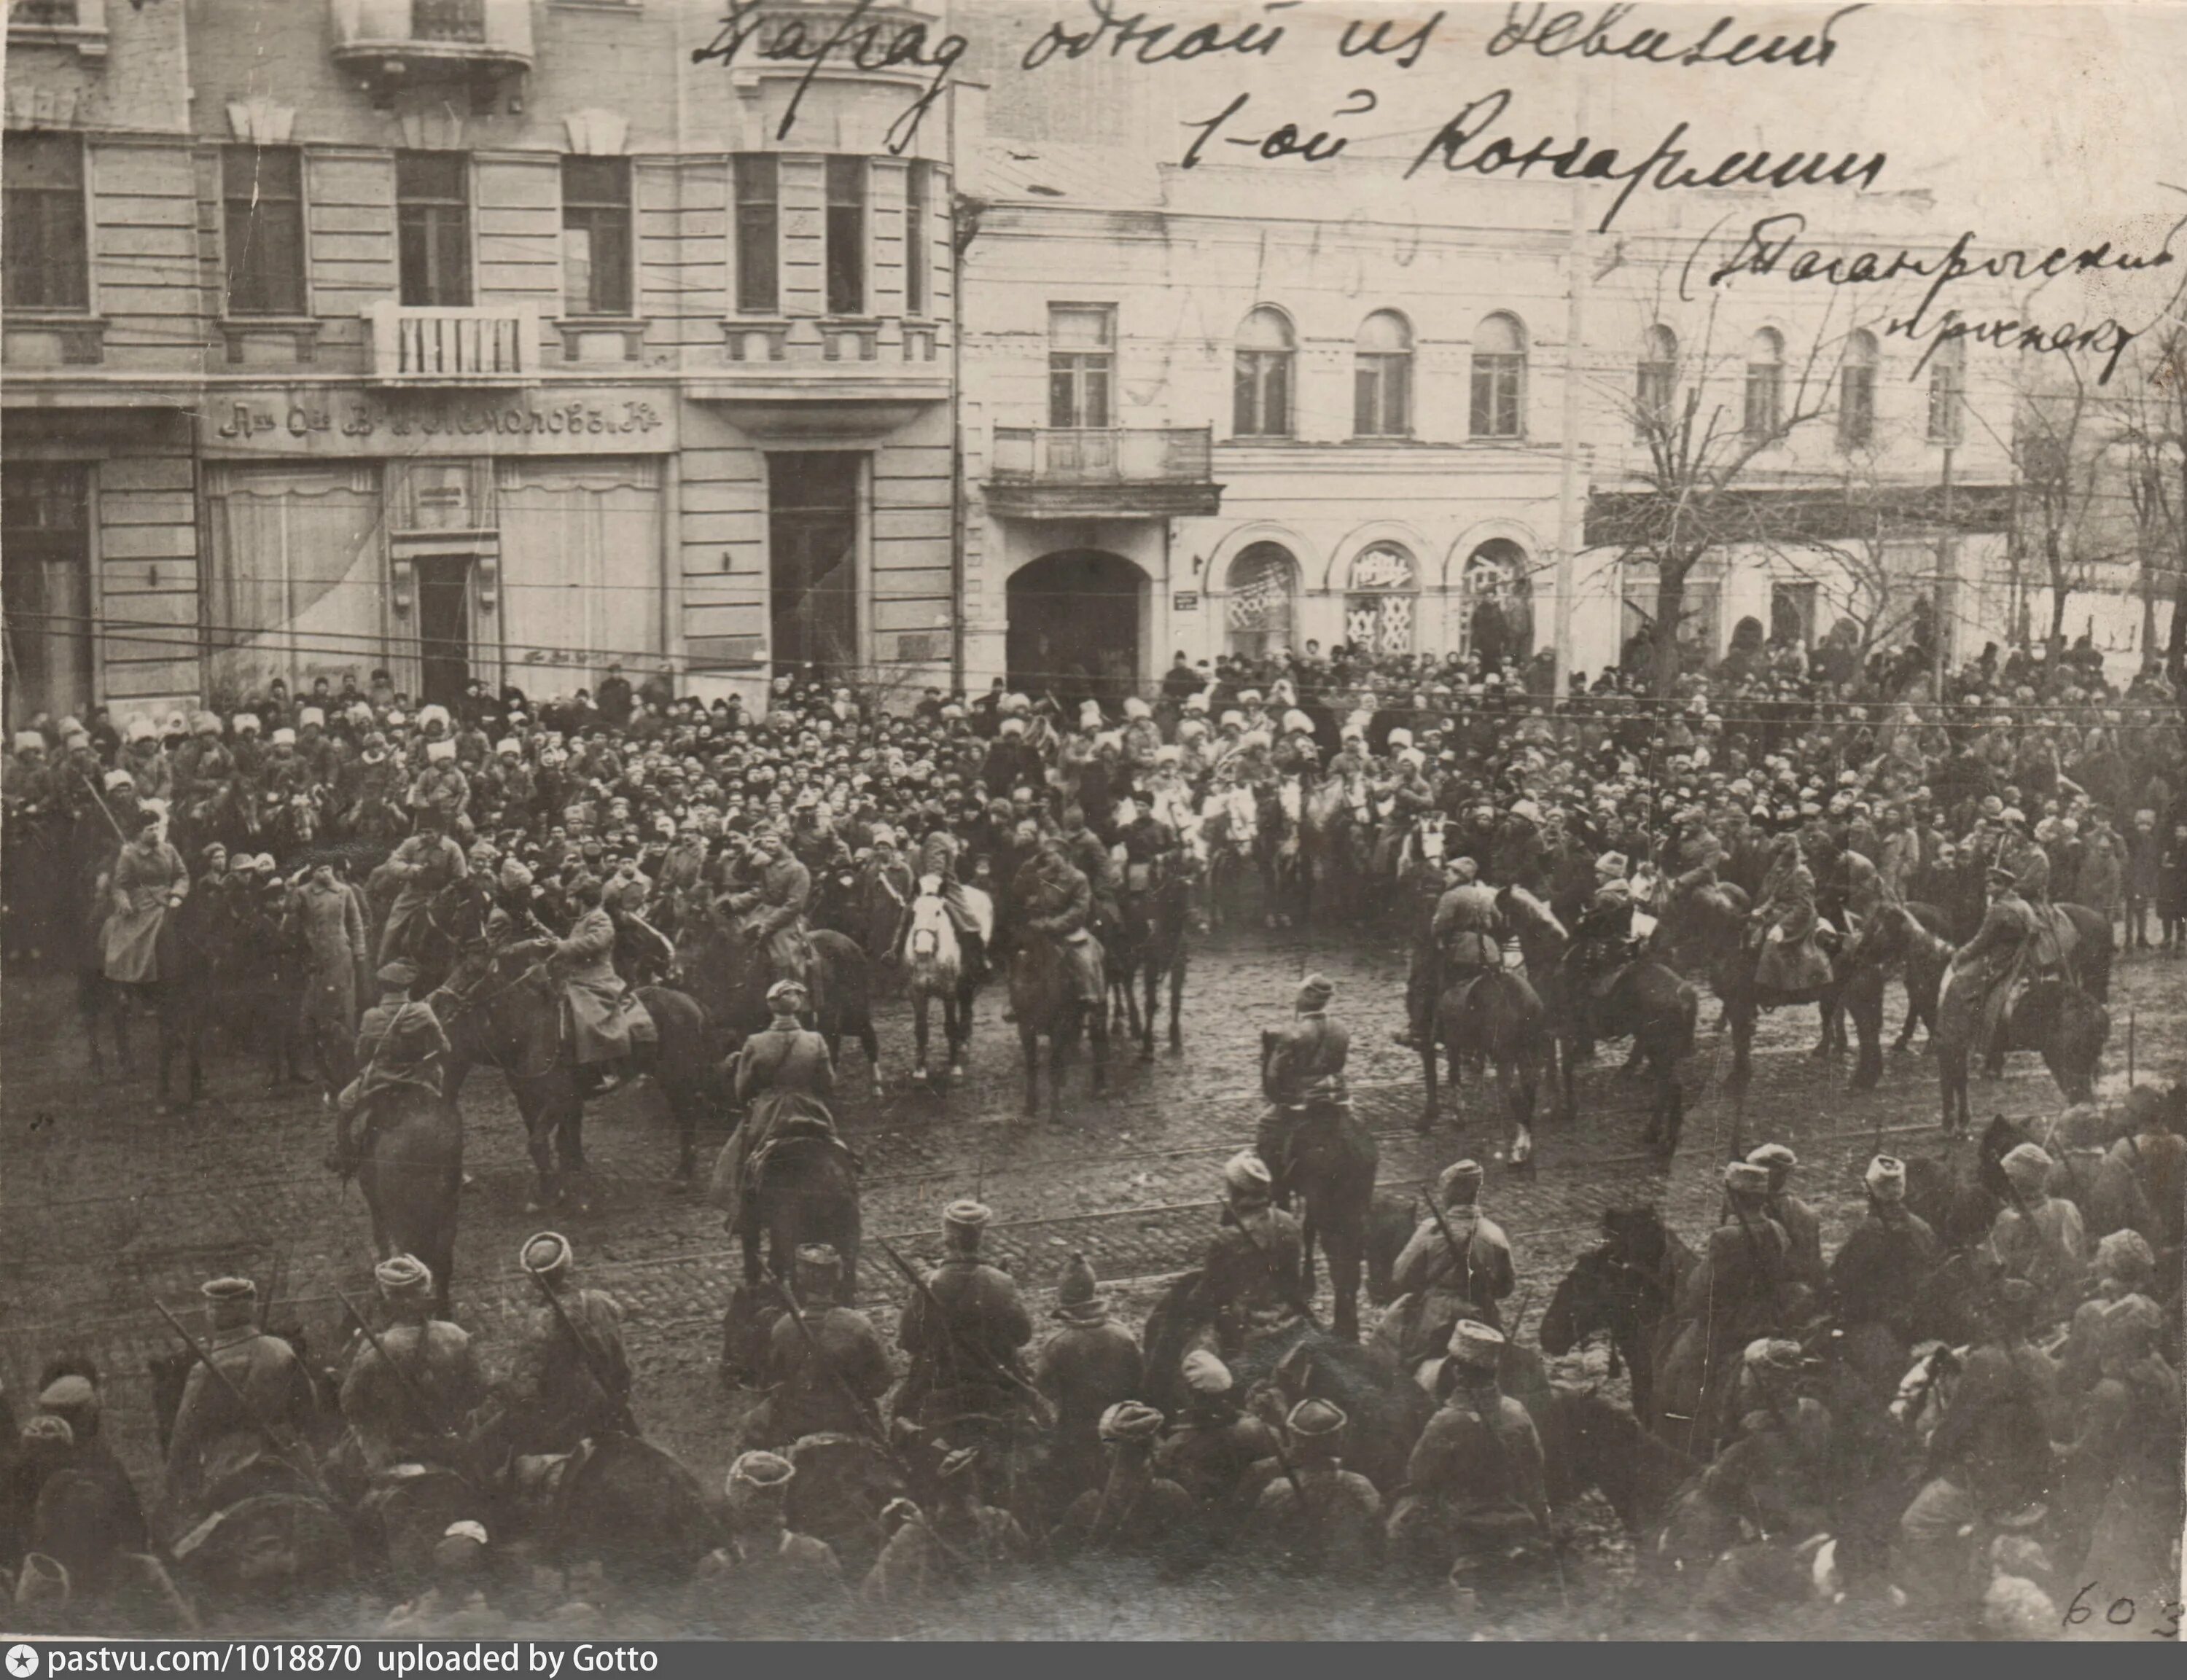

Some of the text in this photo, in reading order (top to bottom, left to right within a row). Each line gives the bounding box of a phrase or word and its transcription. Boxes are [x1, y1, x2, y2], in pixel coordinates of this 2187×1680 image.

[692, 0, 968, 155] Парад
[1021, 0, 1303, 70] одной
[1338, 10, 1448, 68] из
[1180, 89, 1886, 233] 1-ой Конармии
